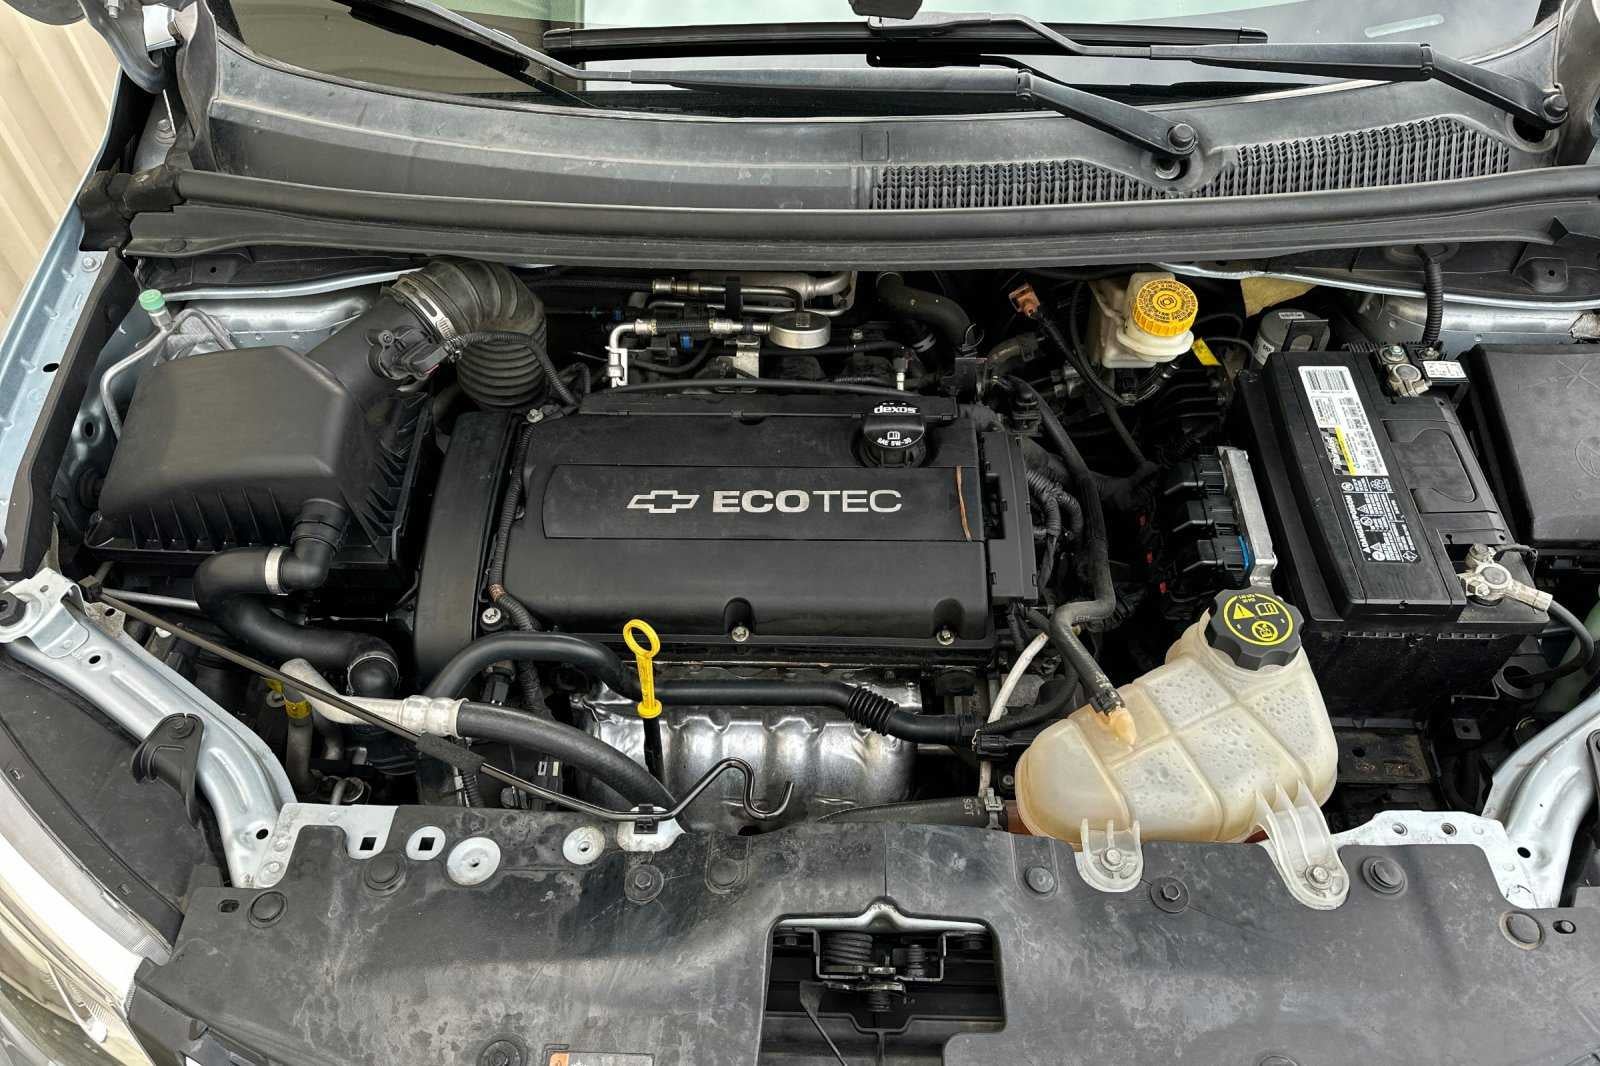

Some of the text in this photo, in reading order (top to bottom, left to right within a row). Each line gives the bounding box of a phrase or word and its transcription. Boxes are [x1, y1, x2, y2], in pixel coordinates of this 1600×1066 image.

[873, 405, 918, 414] dexos
[877, 437, 889, 446] SAE
[712, 489, 903, 513] ECOTEC
